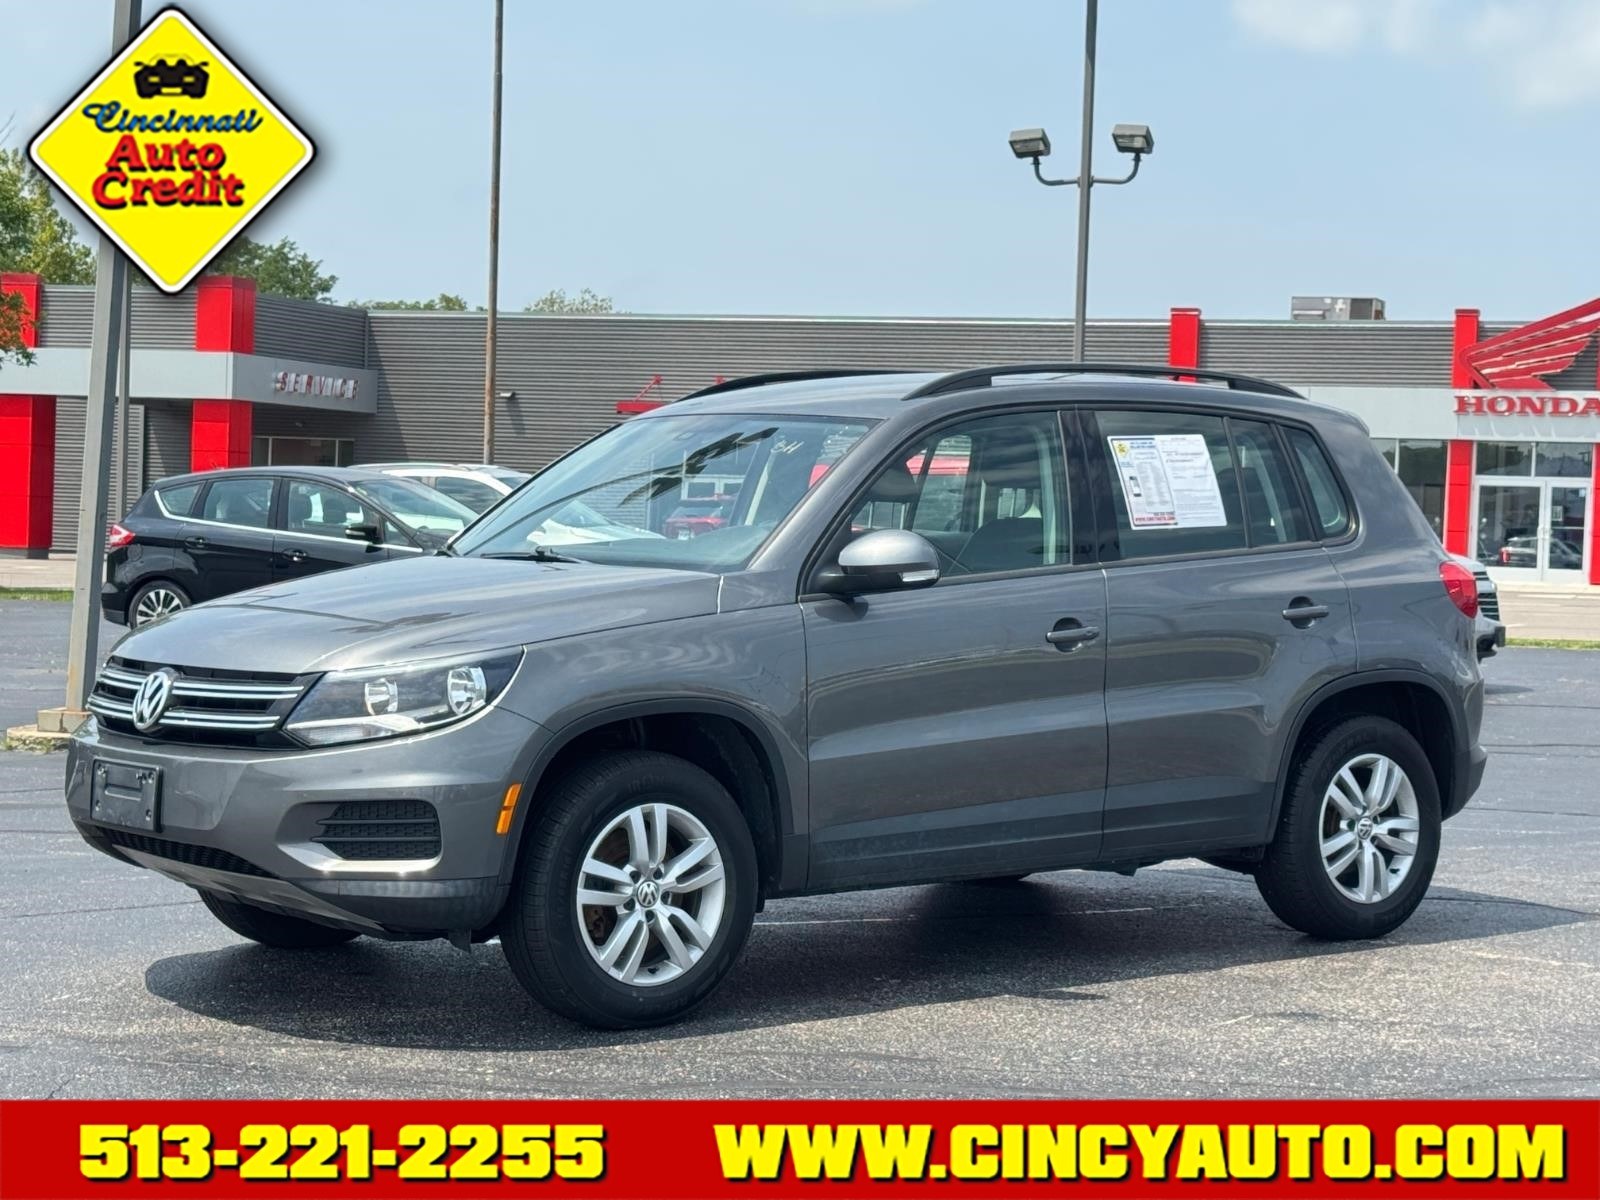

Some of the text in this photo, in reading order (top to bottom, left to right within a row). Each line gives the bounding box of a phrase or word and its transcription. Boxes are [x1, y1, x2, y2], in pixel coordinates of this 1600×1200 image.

[275, 371, 358, 400] SERVICE
[1454, 395, 1600, 417] HONDA
[132, 671, 169, 731] VW
